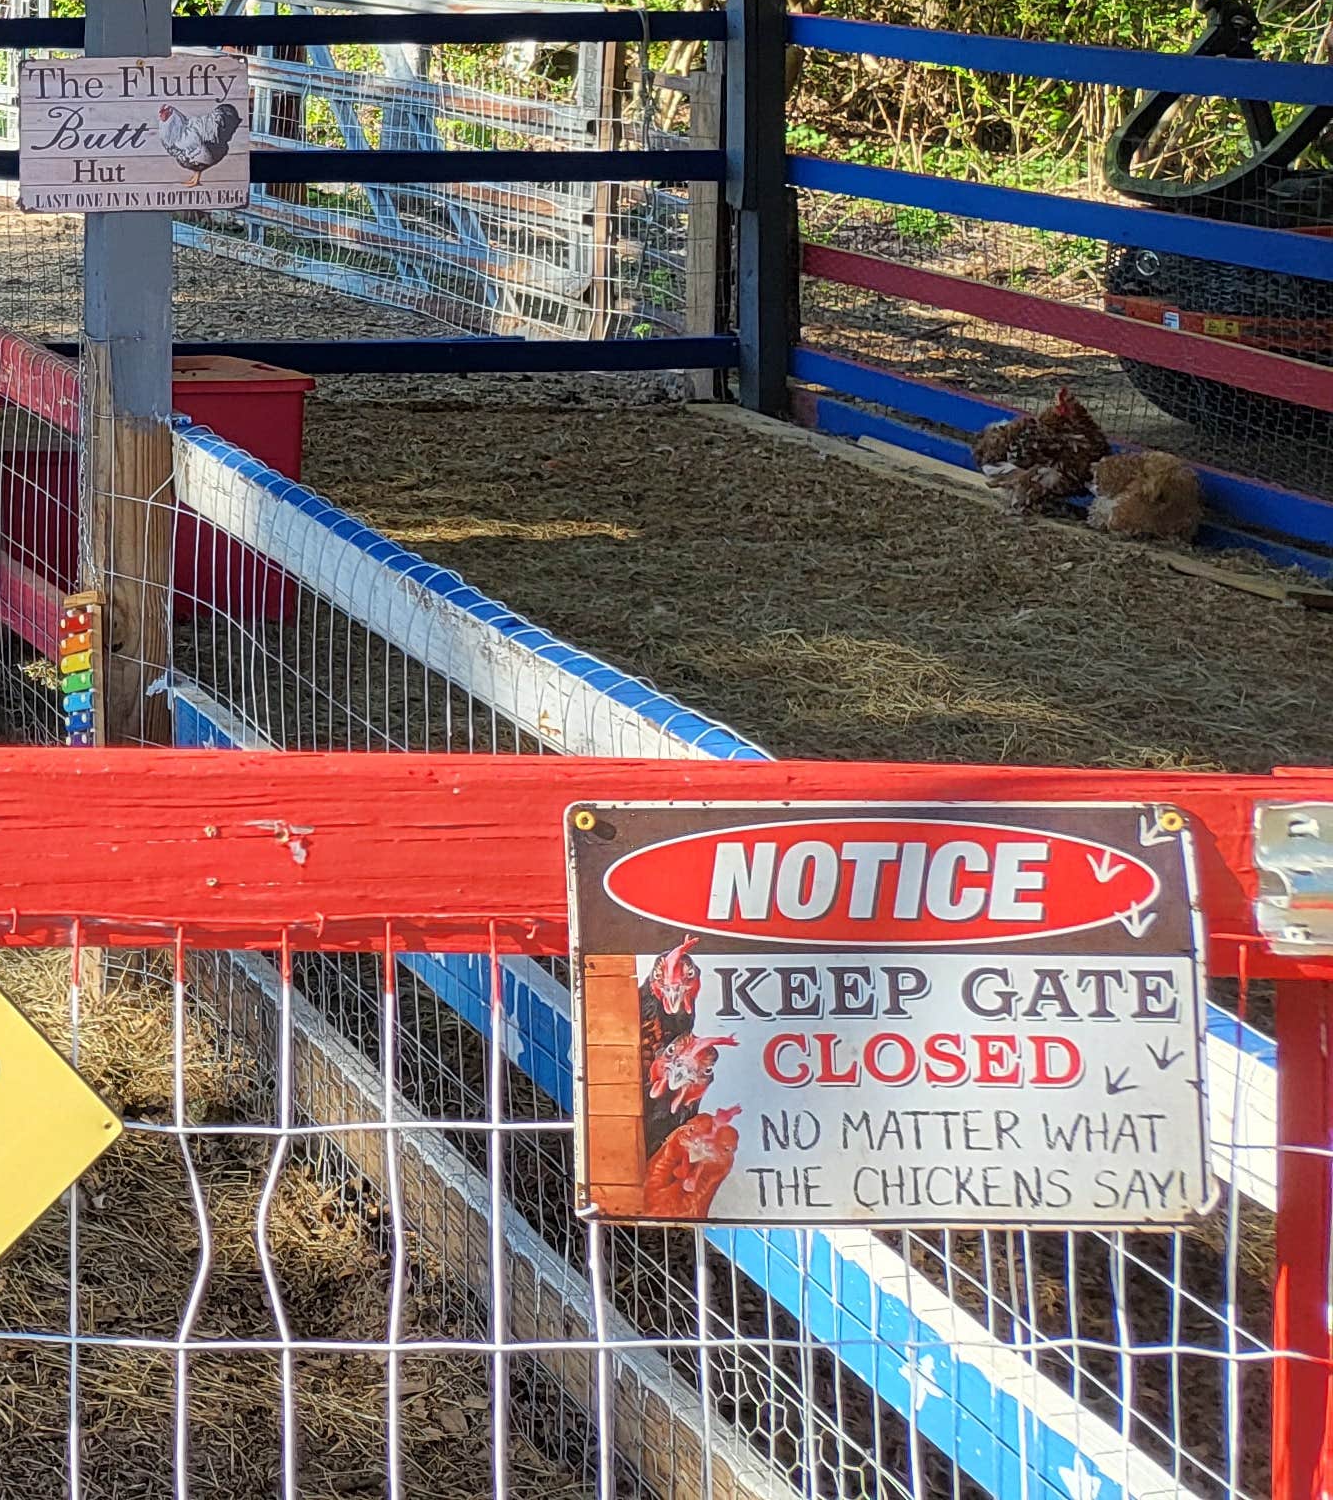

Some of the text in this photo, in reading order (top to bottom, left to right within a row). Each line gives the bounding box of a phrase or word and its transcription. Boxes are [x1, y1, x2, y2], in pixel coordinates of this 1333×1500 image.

[28, 64, 237, 103] The Fluffy
[31, 106, 150, 150] Butt
[72, 160, 126, 183] Hut
[35, 189, 244, 208] LAST ONE IN IS A ROTTEN EGG
[706, 841, 1050, 922] NOTICE
[714, 966, 1180, 1022] KEEP GATE
[762, 1033, 1086, 1089] CLOSED
[761, 1109, 1166, 1156] NO MATTER WHAT
[747, 1164, 1188, 1210] THE CHICKENS SAY!
